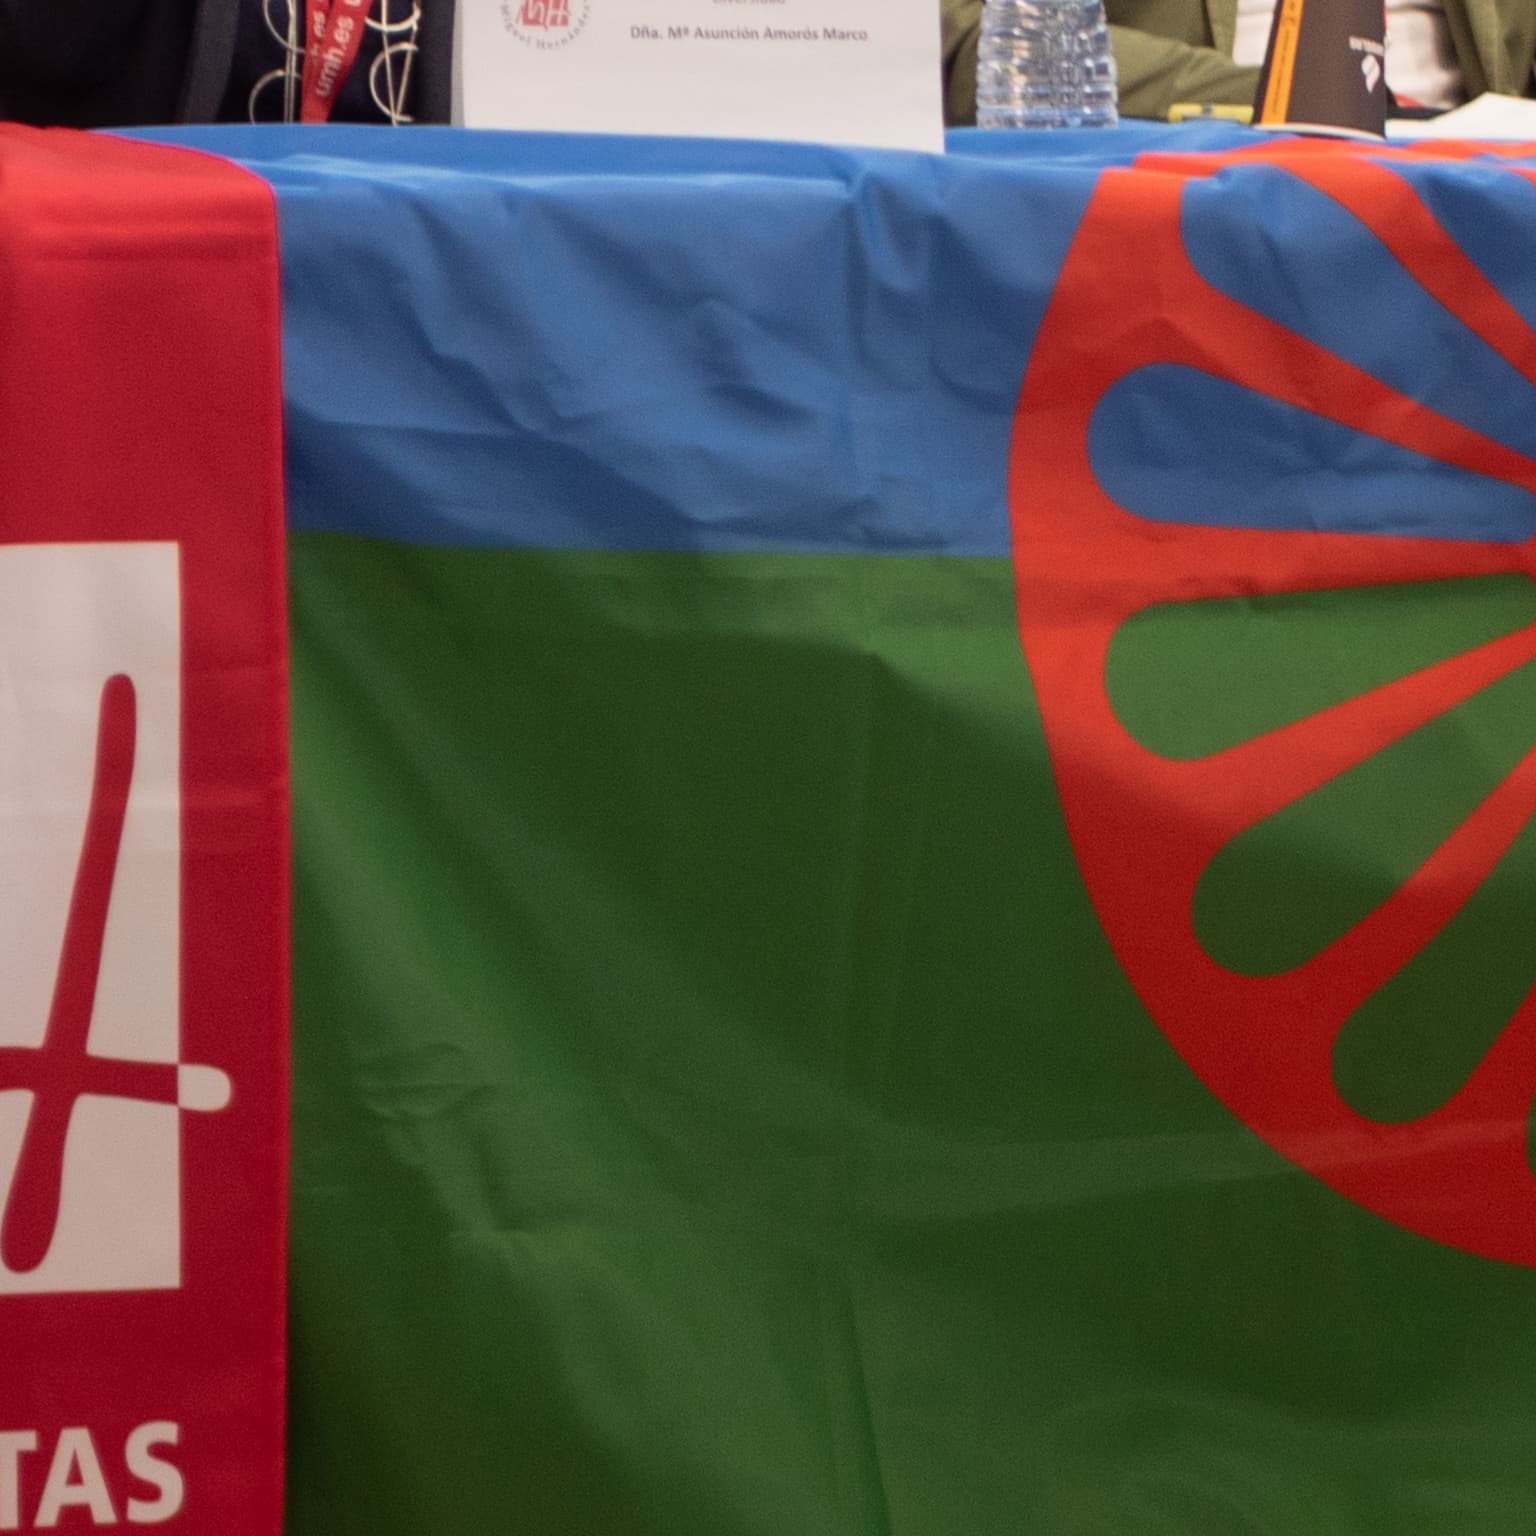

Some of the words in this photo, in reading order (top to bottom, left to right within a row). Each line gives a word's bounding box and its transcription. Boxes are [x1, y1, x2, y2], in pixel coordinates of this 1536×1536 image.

[315, 15, 355, 97] umh.es
[630, 25, 663, 41] Dña.
[694, 26, 760, 41] Asunción
[822, 27, 868, 41] Marco
